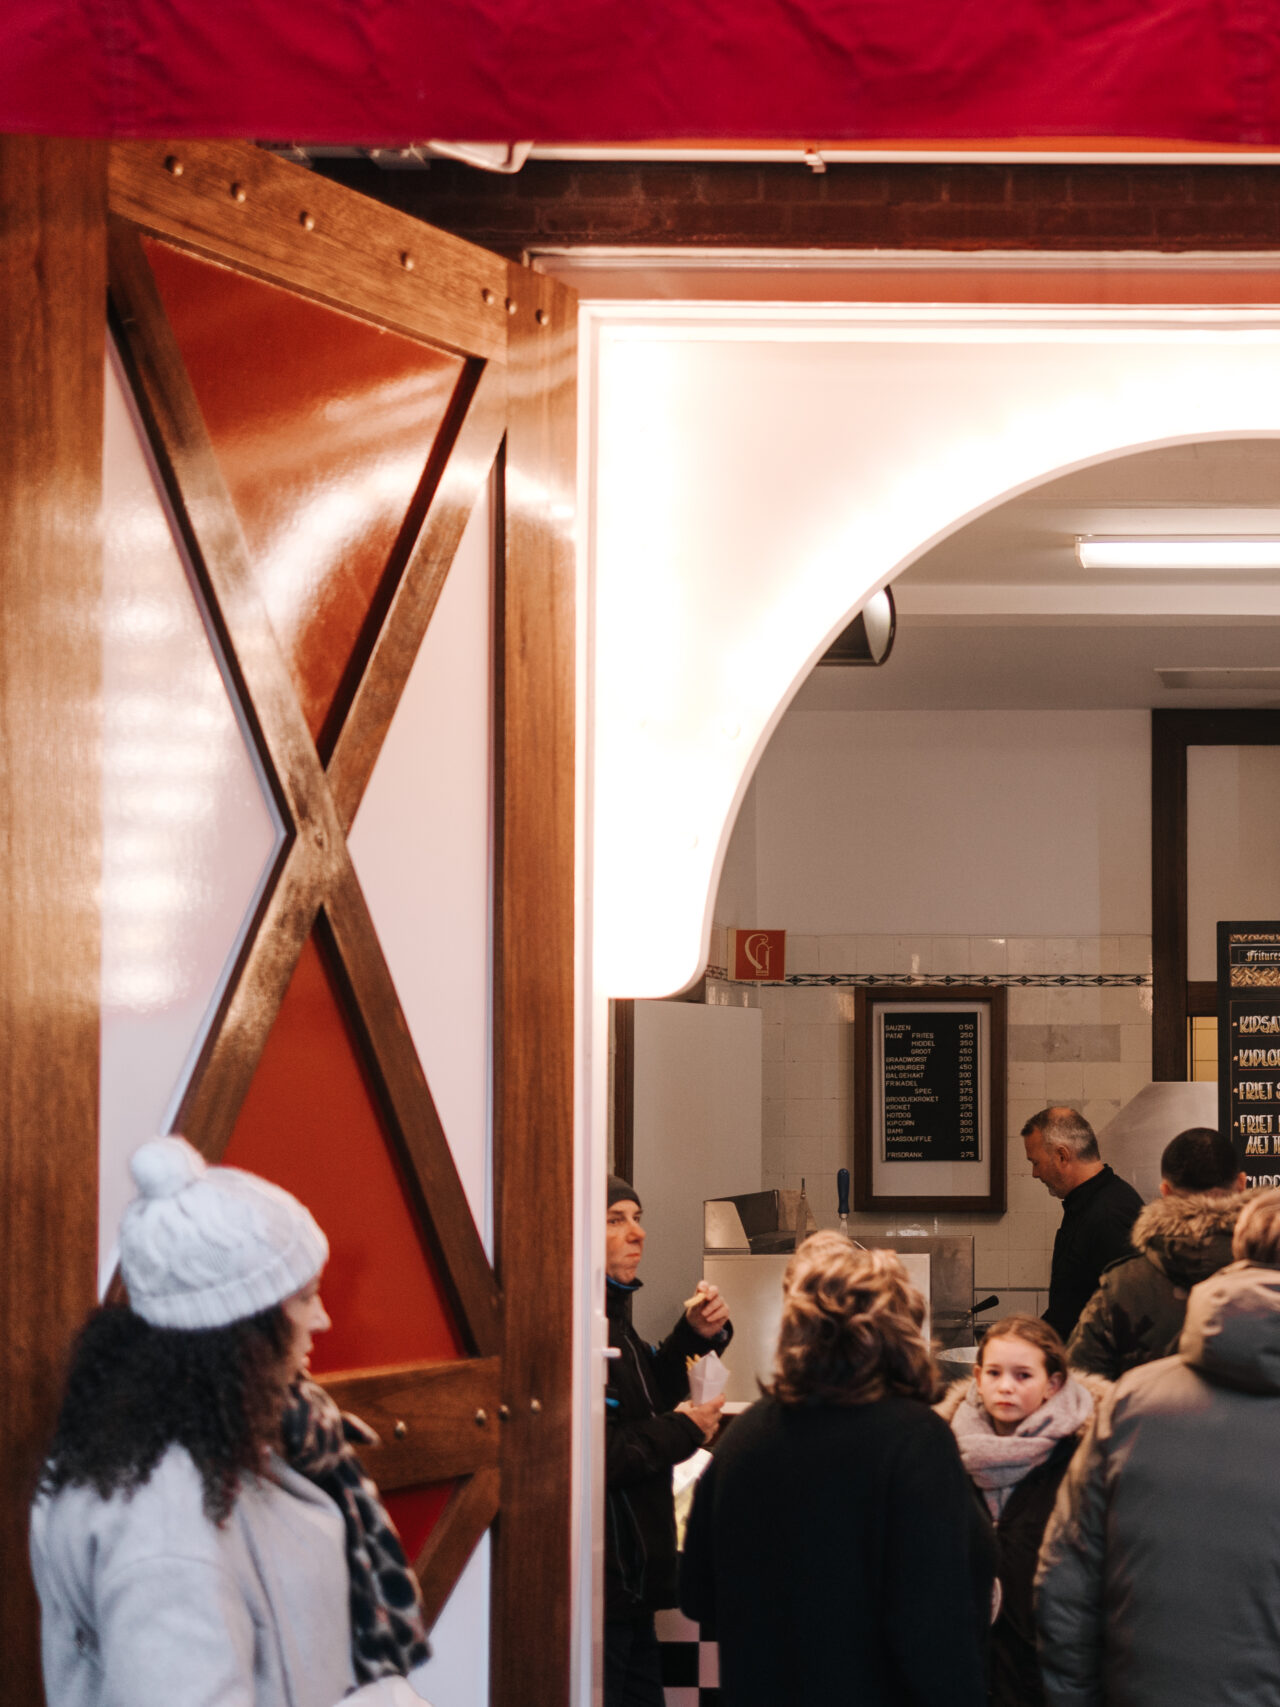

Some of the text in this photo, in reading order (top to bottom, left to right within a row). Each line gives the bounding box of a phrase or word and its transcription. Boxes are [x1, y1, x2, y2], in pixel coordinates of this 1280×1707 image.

[1239, 1081, 1274, 1100] FRIET
[1239, 1114, 1274, 1134] FRIET
[1245, 1135, 1270, 1154] MET
